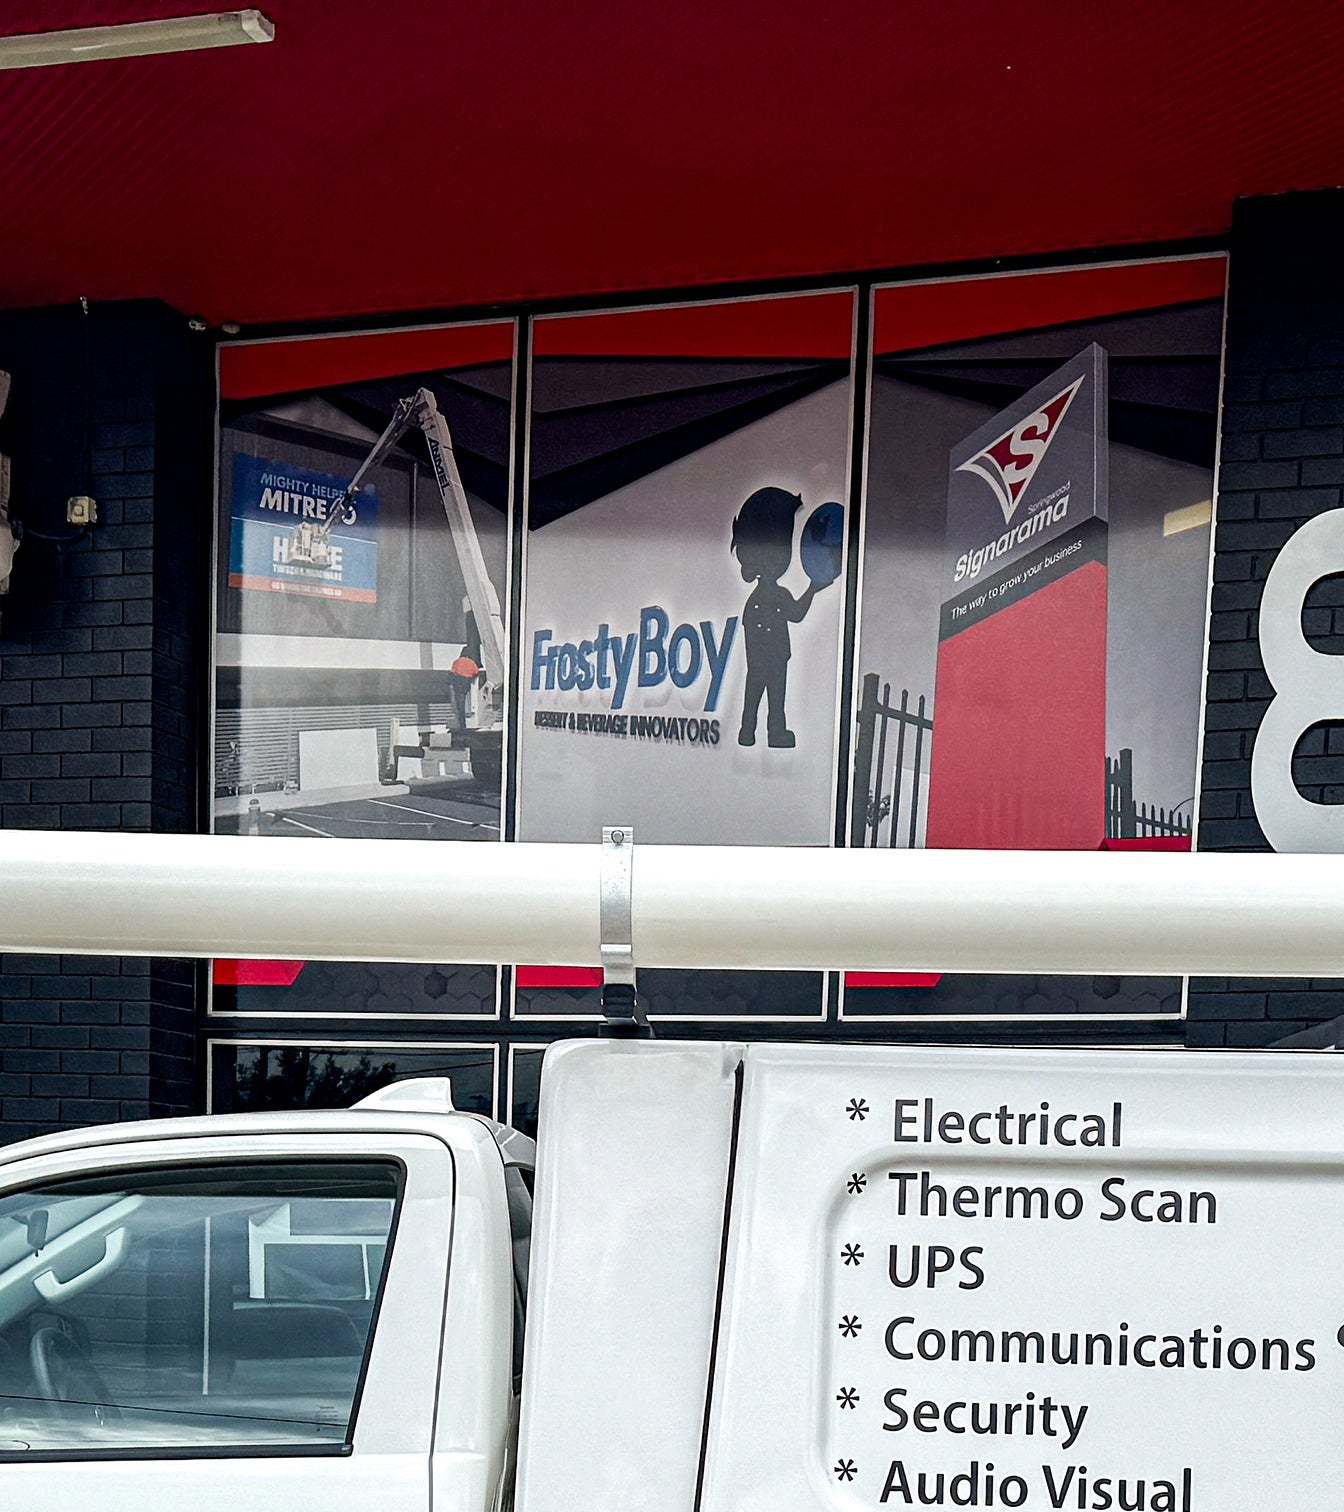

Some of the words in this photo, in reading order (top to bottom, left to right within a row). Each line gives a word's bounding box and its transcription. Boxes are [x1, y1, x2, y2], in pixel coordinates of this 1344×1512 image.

[259, 488, 327, 520] MITRE
[260, 472, 309, 493] MIGHTY
[272, 536, 343, 571] HE
[953, 494, 1070, 582] Signarama
[952, 604, 967, 620] The
[969, 594, 988, 611] way
[988, 586, 999, 599] to
[999, 573, 1022, 596] grow
[1022, 561, 1043, 583] your
[1044, 539, 1083, 568] business
[630, 714, 720, 745] INNOVATORS
[893, 1098, 1122, 1147] Electrical
[889, 1171, 1084, 1220] Thermo
[1100, 1177, 1218, 1223] Scan
[888, 1245, 985, 1289] UPS
[884, 1316, 1316, 1371] Communications
[882, 1388, 1088, 1449] Security
[880, 1460, 1028, 1507] Audio
[1042, 1465, 1192, 1512] Visual
